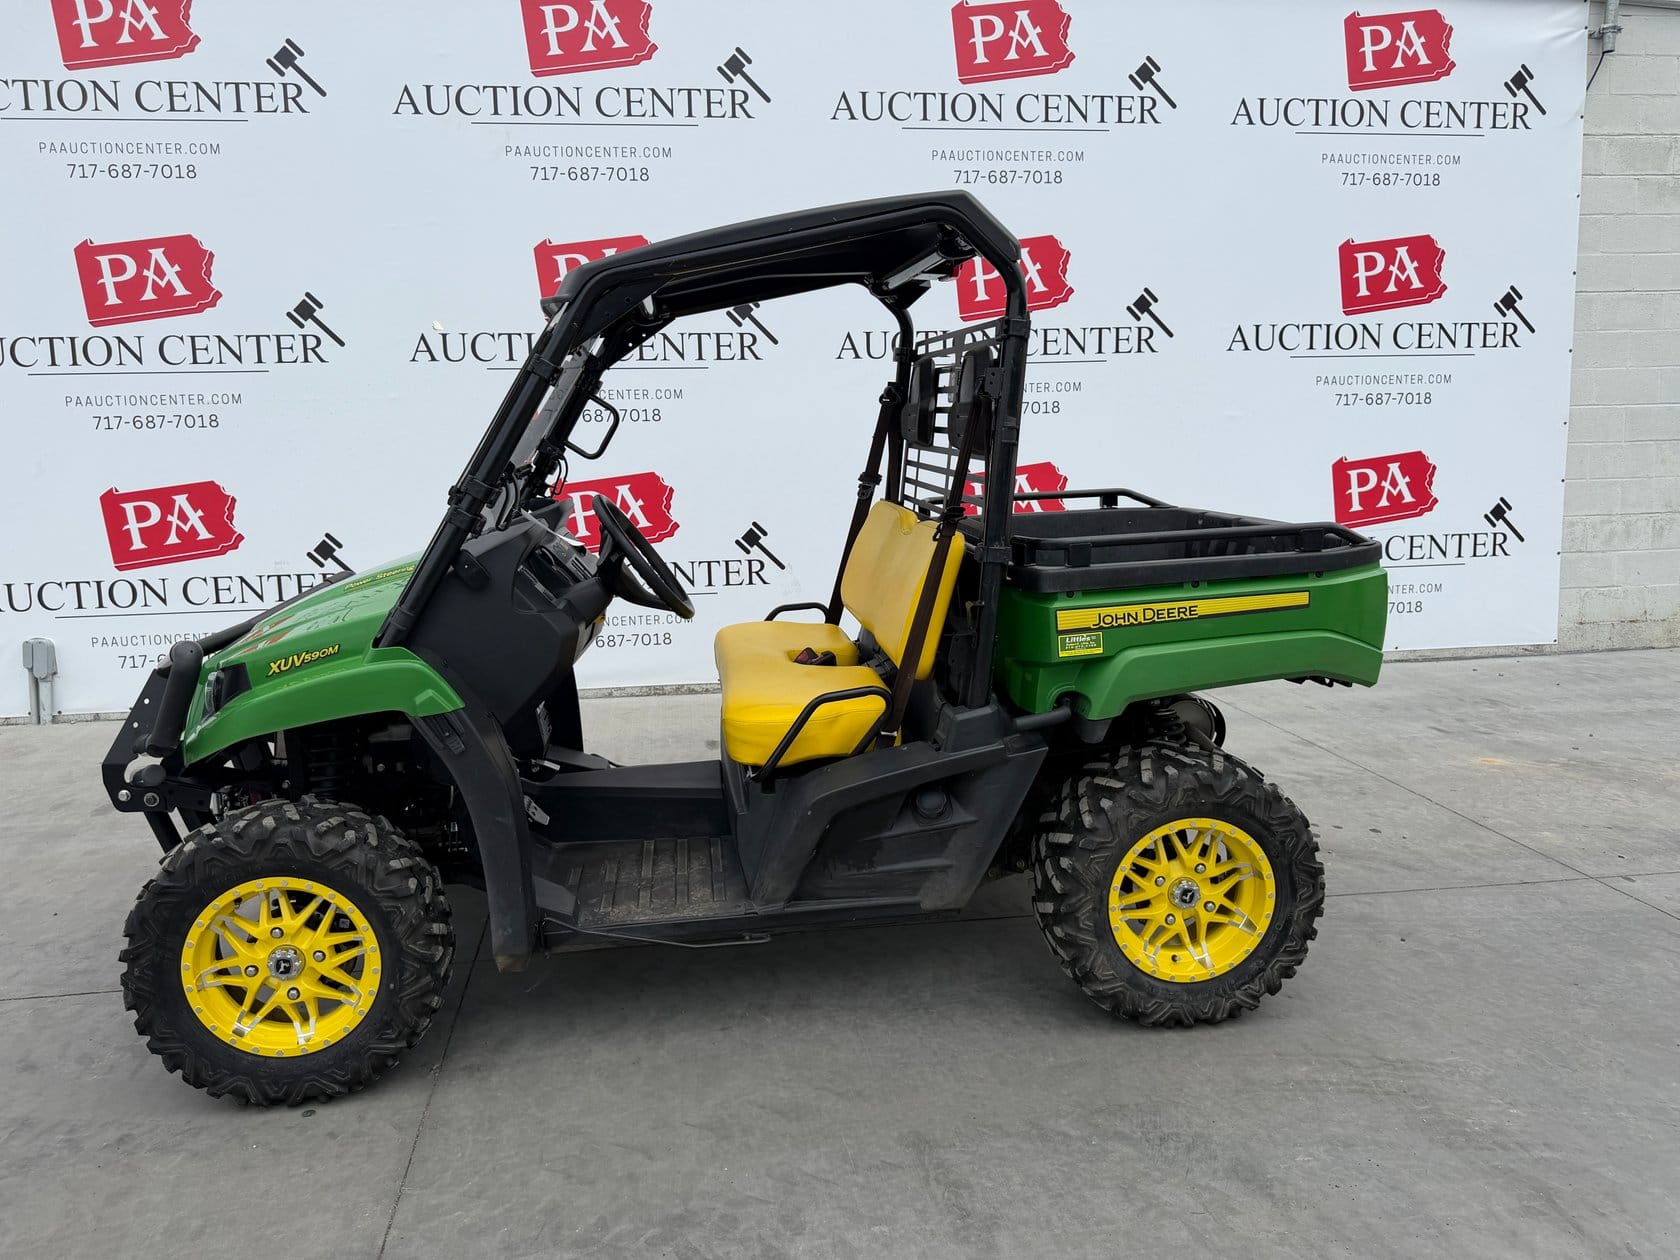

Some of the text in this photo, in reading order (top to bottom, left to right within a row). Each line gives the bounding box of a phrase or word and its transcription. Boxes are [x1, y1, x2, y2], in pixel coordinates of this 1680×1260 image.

[73, 0, 170, 48] PA
[540, 0, 629, 56] PA
[968, 10, 1050, 64] PA
[1359, 20, 1432, 72] PA
[0, 79, 310, 114] TION CENTER
[392, 84, 756, 119] AUCTION CENTER
[830, 91, 1162, 124] AUCTION CENTER
[1230, 97, 1532, 130] AUCTION CENTER
[39, 142, 221, 155] PAAUCTIONCENTER.COM
[505, 145, 672, 159] PAAUCTIONCENTER.COM
[931, 149, 1085, 162] PAAUCTIONCENTER.COM
[1321, 153, 1461, 166] PAAUCTIONCENTER.COM
[67, 163, 197, 179] 717-687-7018
[530, 166, 650, 182] 717-687-7018
[953, 170, 1063, 185] 717-687-7018
[1341, 172, 1441, 187] 717-687-7018
[94, 247, 192, 306] PA
[1353, 245, 1424, 297] PA
[0, 334, 327, 367] CTION CENTER
[410, 331, 763, 362] AUCTI ENTER
[1226, 322, 1522, 351] AUCTION CENTER
[1315, 373, 1452, 386] PAAUCTIONCENTER.COM
[65, 393, 242, 407] PAAUCTIONCENTER.COM
[1334, 391, 1432, 406] 717-687-7018
[92, 414, 219, 430] 717-687-7018
[1346, 462, 1416, 512] PA
[120, 494, 215, 550] PA
[567, 484, 654, 538] PA
[1385, 532, 1511, 561] CENTER
[668, 559, 771, 588] NTER
[0, 578, 168, 612] UCTION
[1092, 606, 1199, 627] JOHN DEERE
[595, 632, 672, 648] 687-7018
[267, 644, 340, 677] XUV590M
